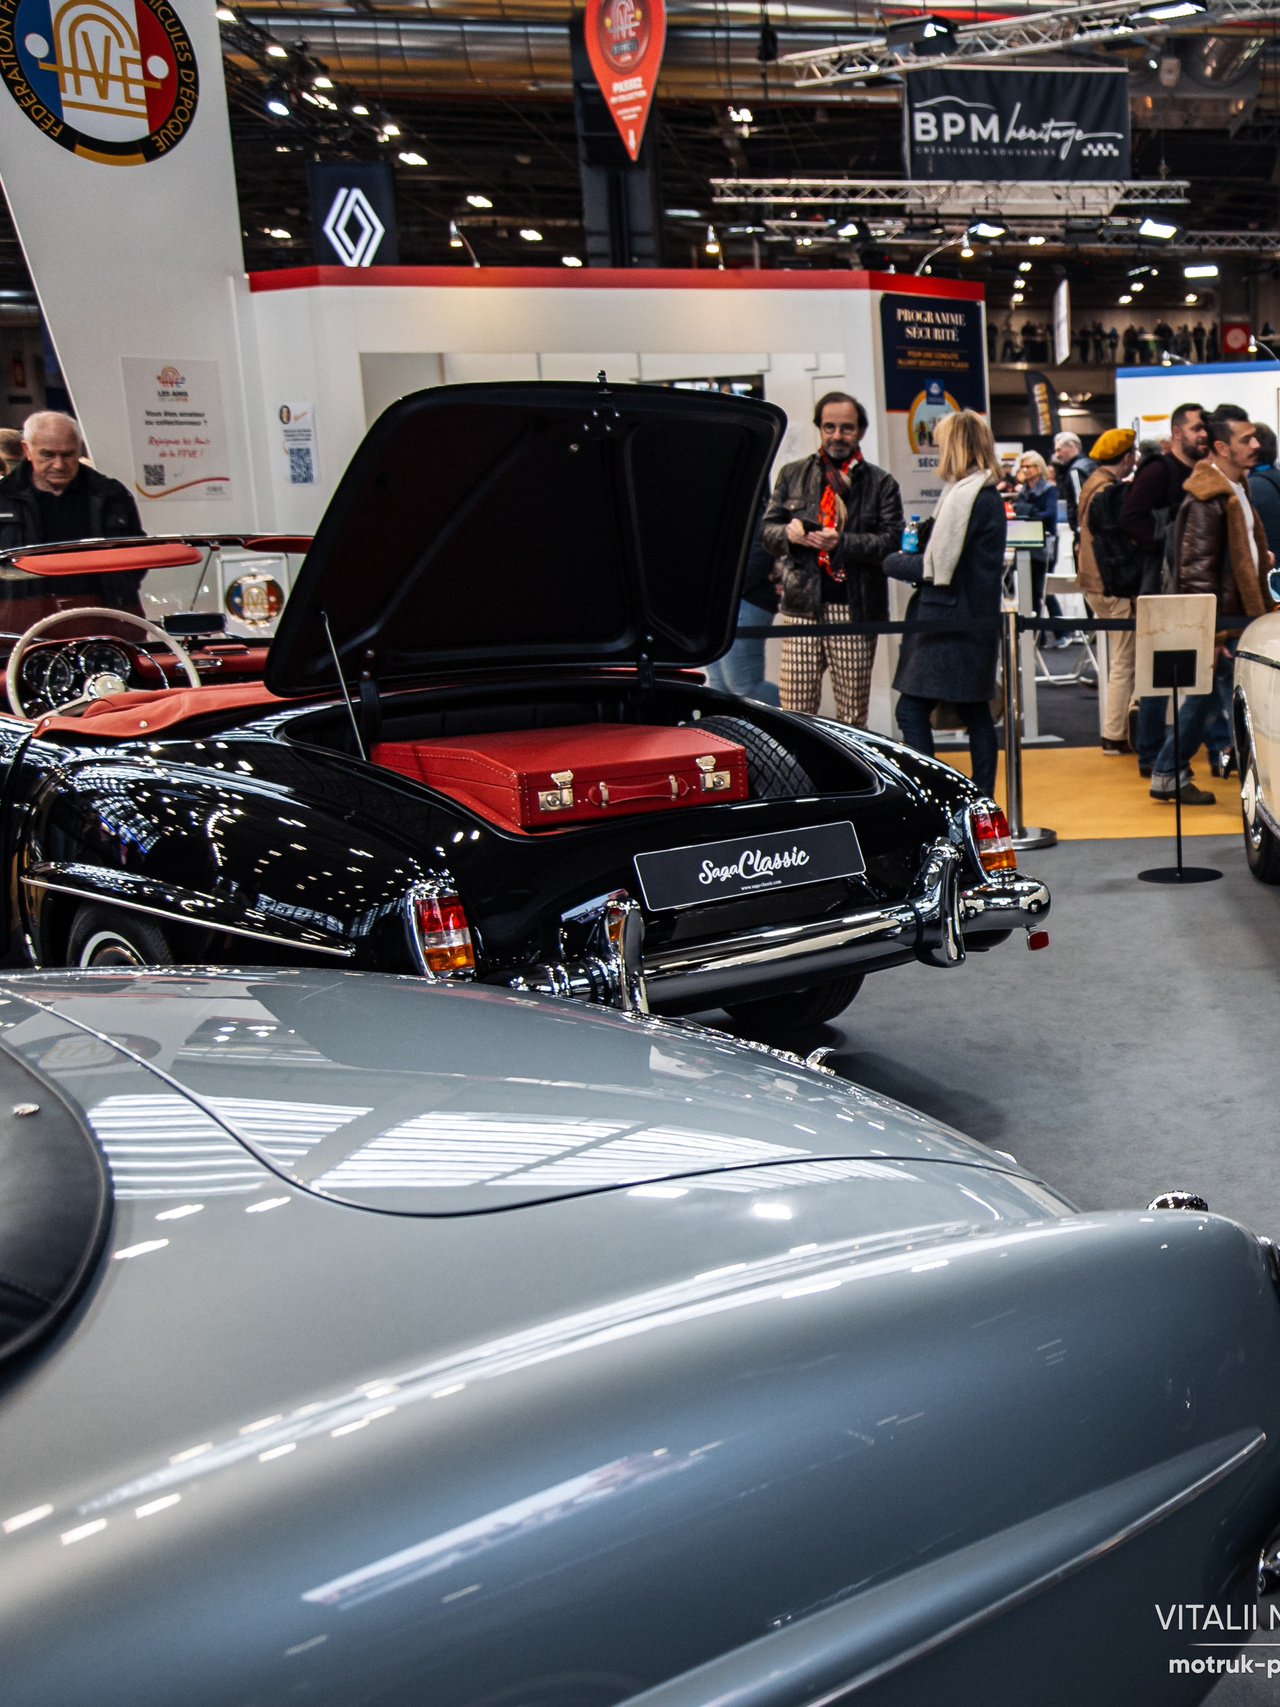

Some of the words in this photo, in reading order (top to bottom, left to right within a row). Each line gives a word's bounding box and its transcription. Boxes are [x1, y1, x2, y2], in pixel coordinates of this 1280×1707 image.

[151, 67, 199, 153] D'ÉPOQUE
[913, 112, 1000, 143] BPM
[896, 308, 966, 326] PROGRAMME
[905, 322, 960, 342] SÉCURITÉ
[740, 879, 782, 891] www.saga-classic.com
